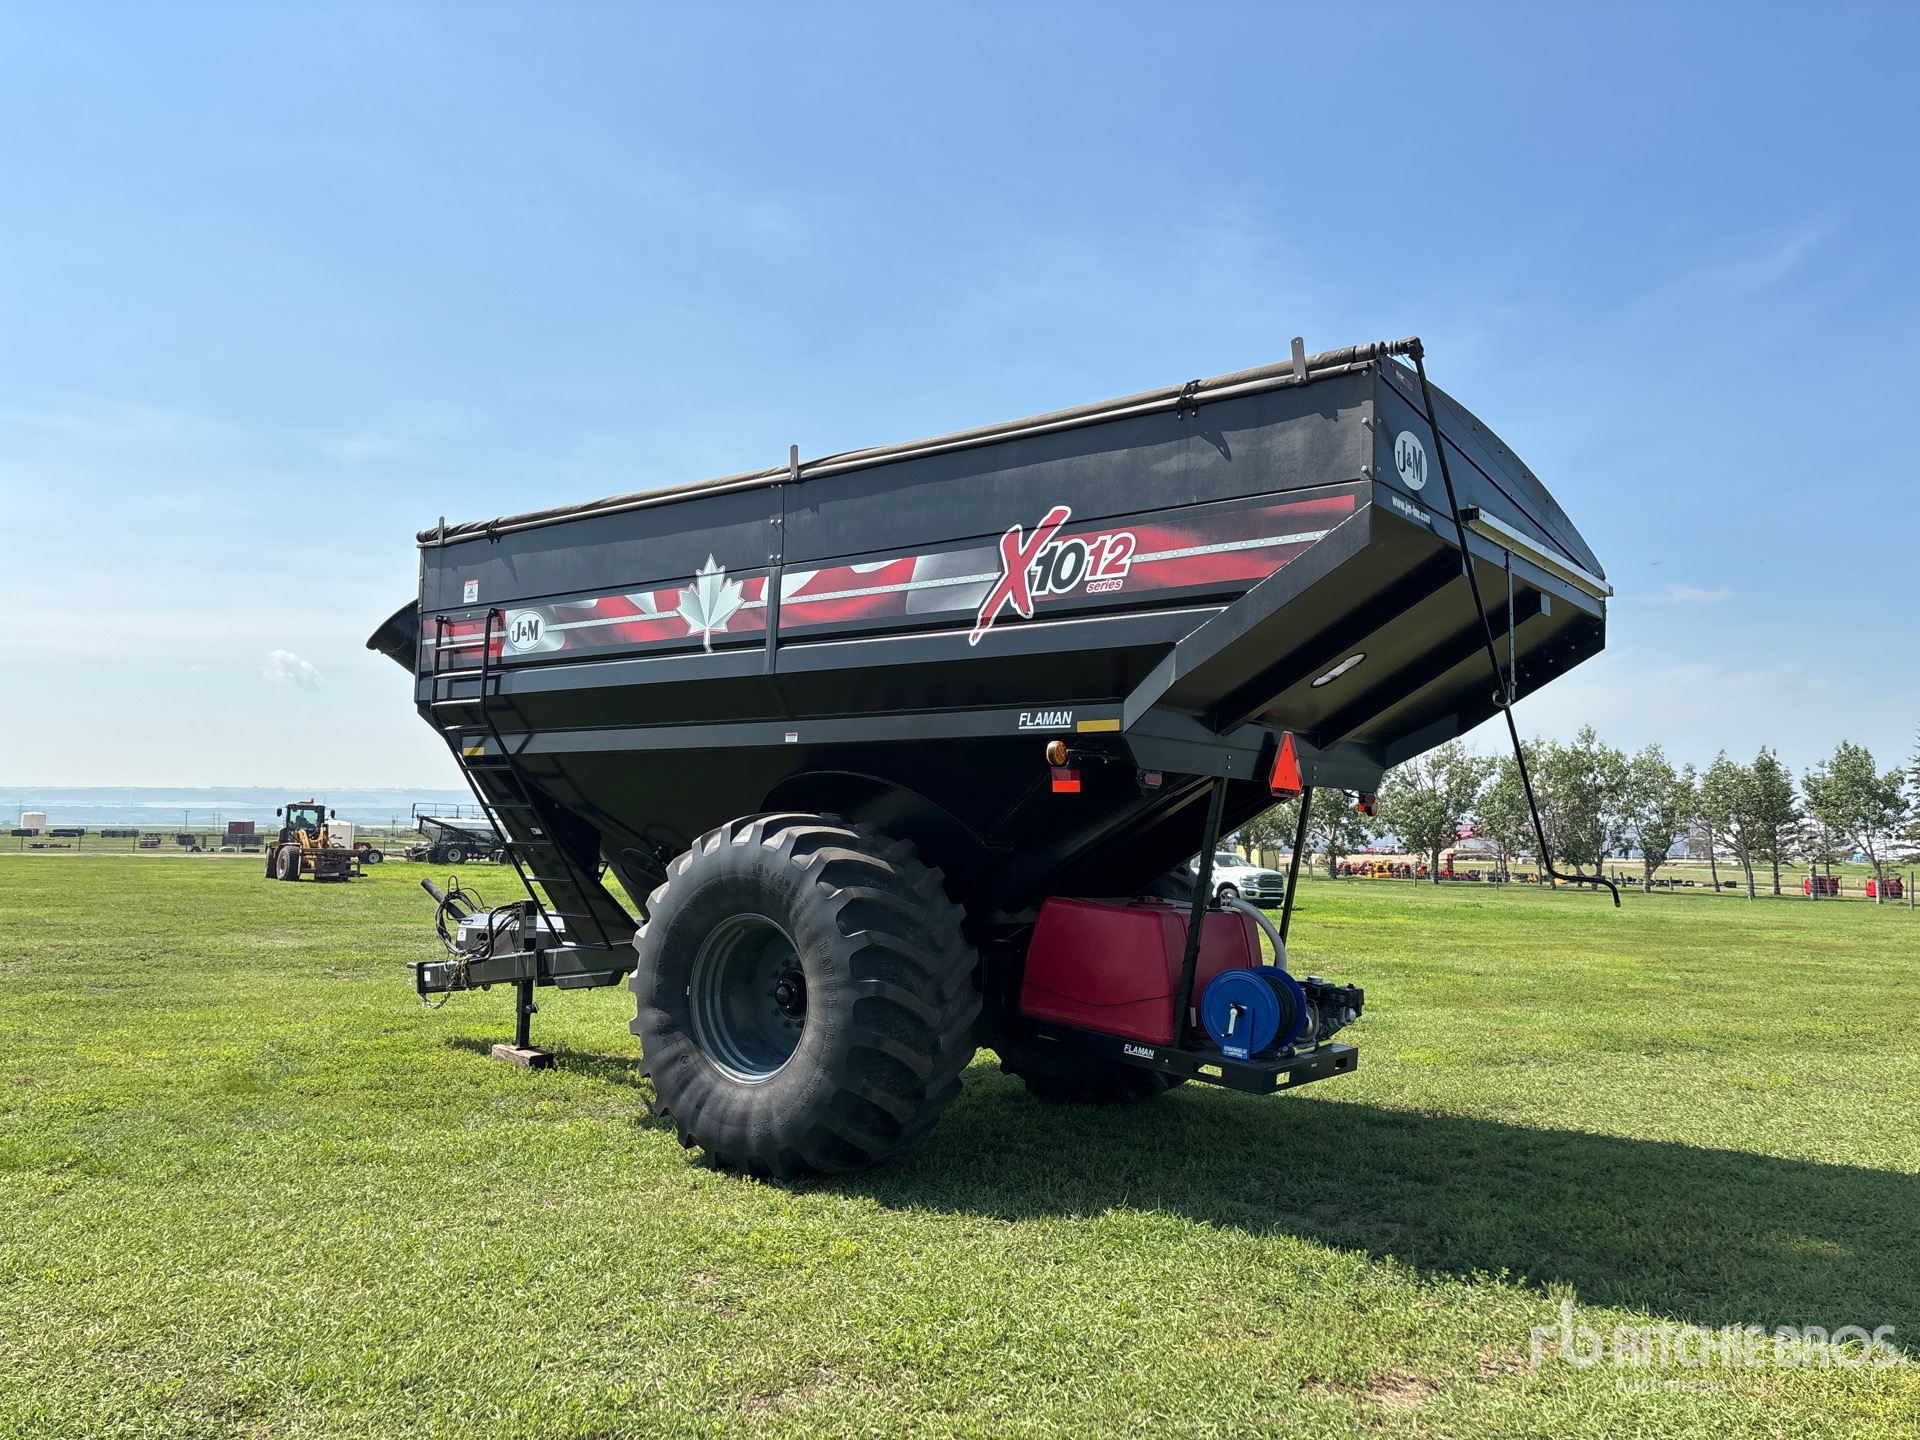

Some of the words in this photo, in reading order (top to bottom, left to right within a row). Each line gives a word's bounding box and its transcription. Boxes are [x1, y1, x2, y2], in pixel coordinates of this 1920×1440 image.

[1397, 440, 1423, 483] J&M
[1086, 578, 1124, 593] series
[511, 619, 540, 643] J&M
[1018, 710, 1073, 726] FLAMAN
[817, 941, 838, 1009] RADIAL
[822, 1018, 837, 1057] ALL
[1123, 1044, 1155, 1058] FLAMAN
